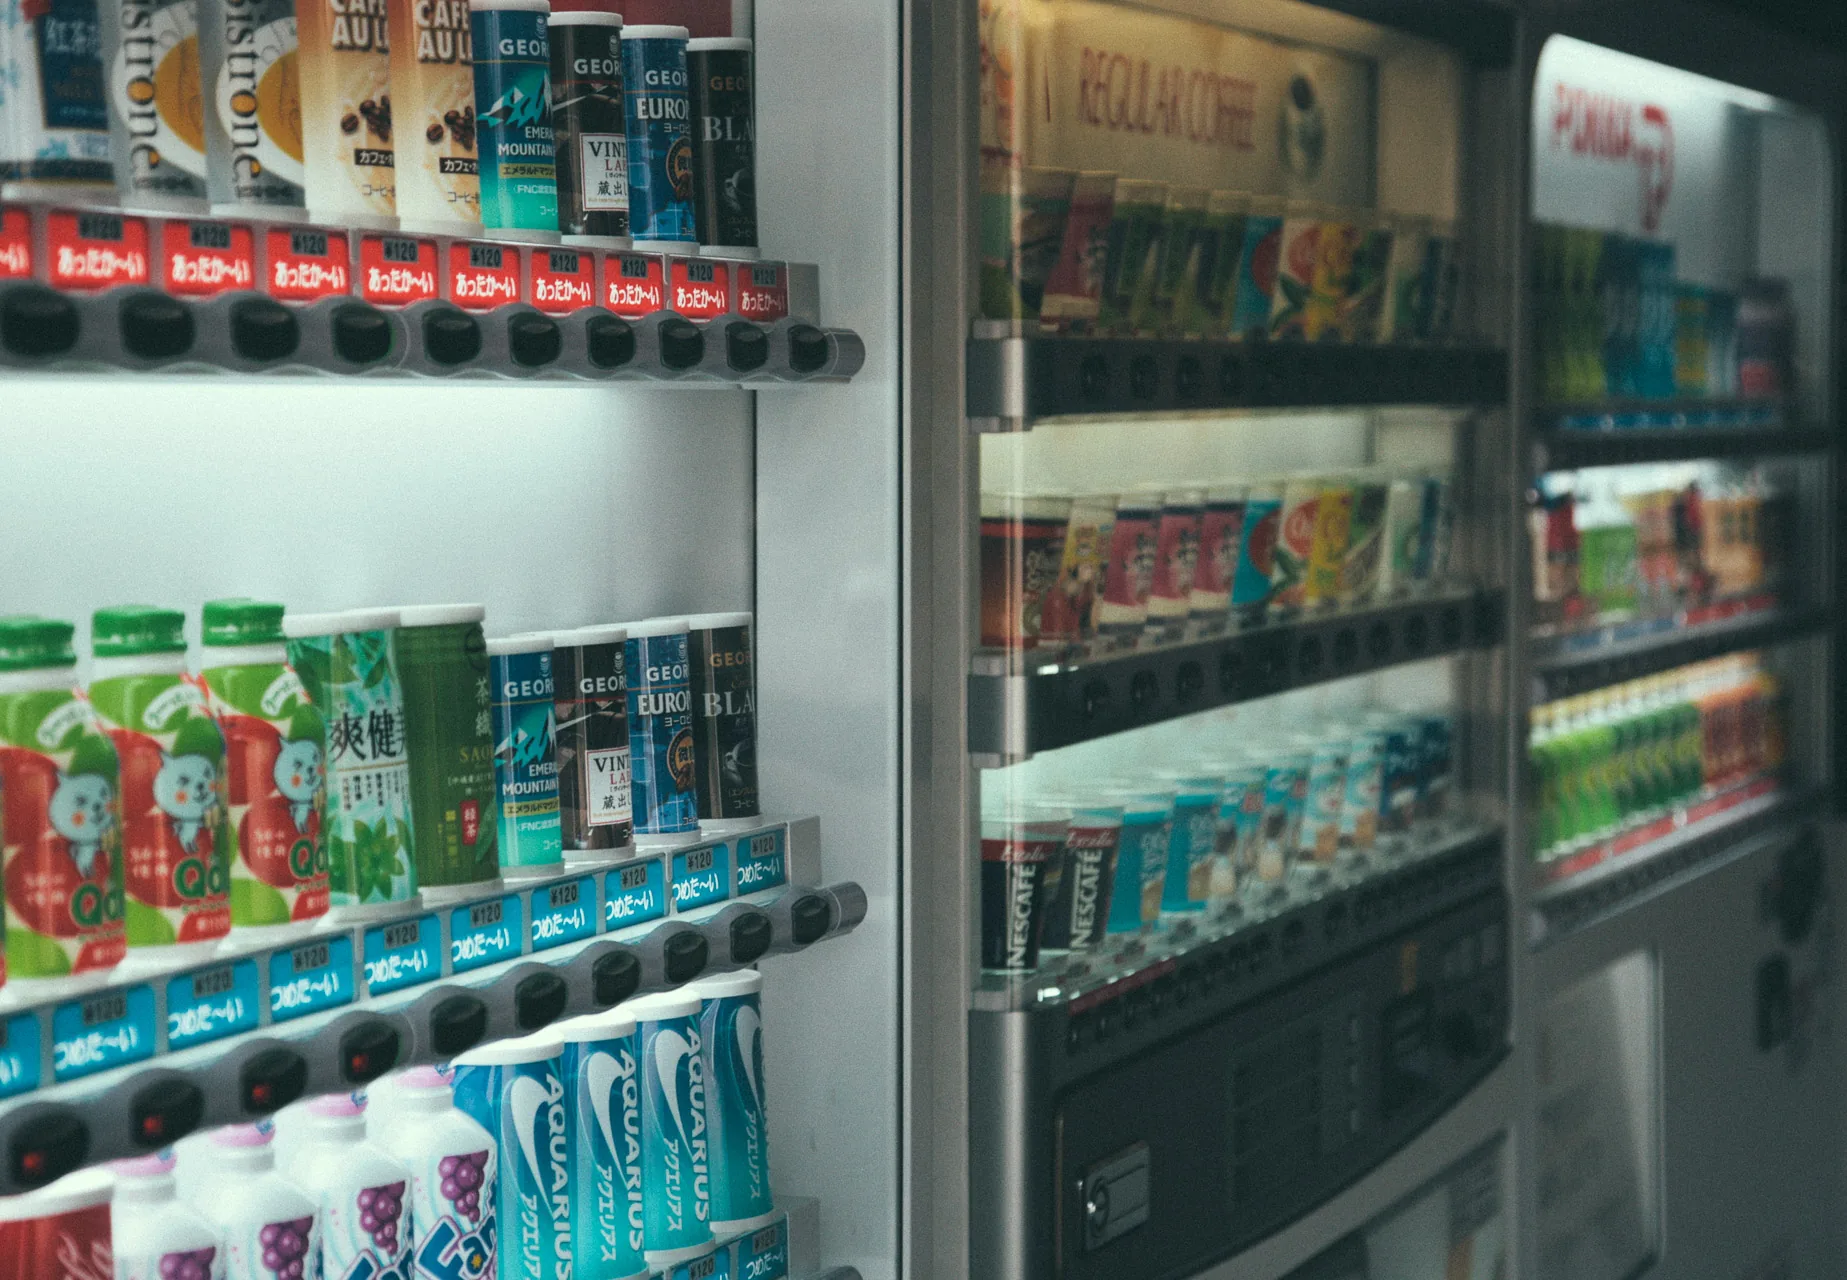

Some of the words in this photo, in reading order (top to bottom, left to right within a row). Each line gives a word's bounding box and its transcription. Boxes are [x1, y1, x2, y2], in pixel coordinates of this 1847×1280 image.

[331, 17, 371, 47] AU
[417, 30, 453, 60] AU
[470, 248, 501, 267] ¥120
[550, 253, 578, 272] ¥120
[620, 259, 647, 278] ¥120
[688, 264, 713, 281] ¥120
[751, 836, 774, 854] ¥120
[687, 851, 712, 869] ¥120
[622, 867, 646, 887] ¥120
[550, 884, 578, 906] ¥120
[471, 903, 502, 926] ¥120
[686, 1026, 710, 1222] AQUARIUS
[618, 1048, 645, 1251] AQUARIUS
[662, 1136, 683, 1232] アクエリアス
[596, 1163, 617, 1262] アクエリアス
[519, 1192, 542, 1280] アクエリア
[690, 1257, 714, 1280] ¥120
